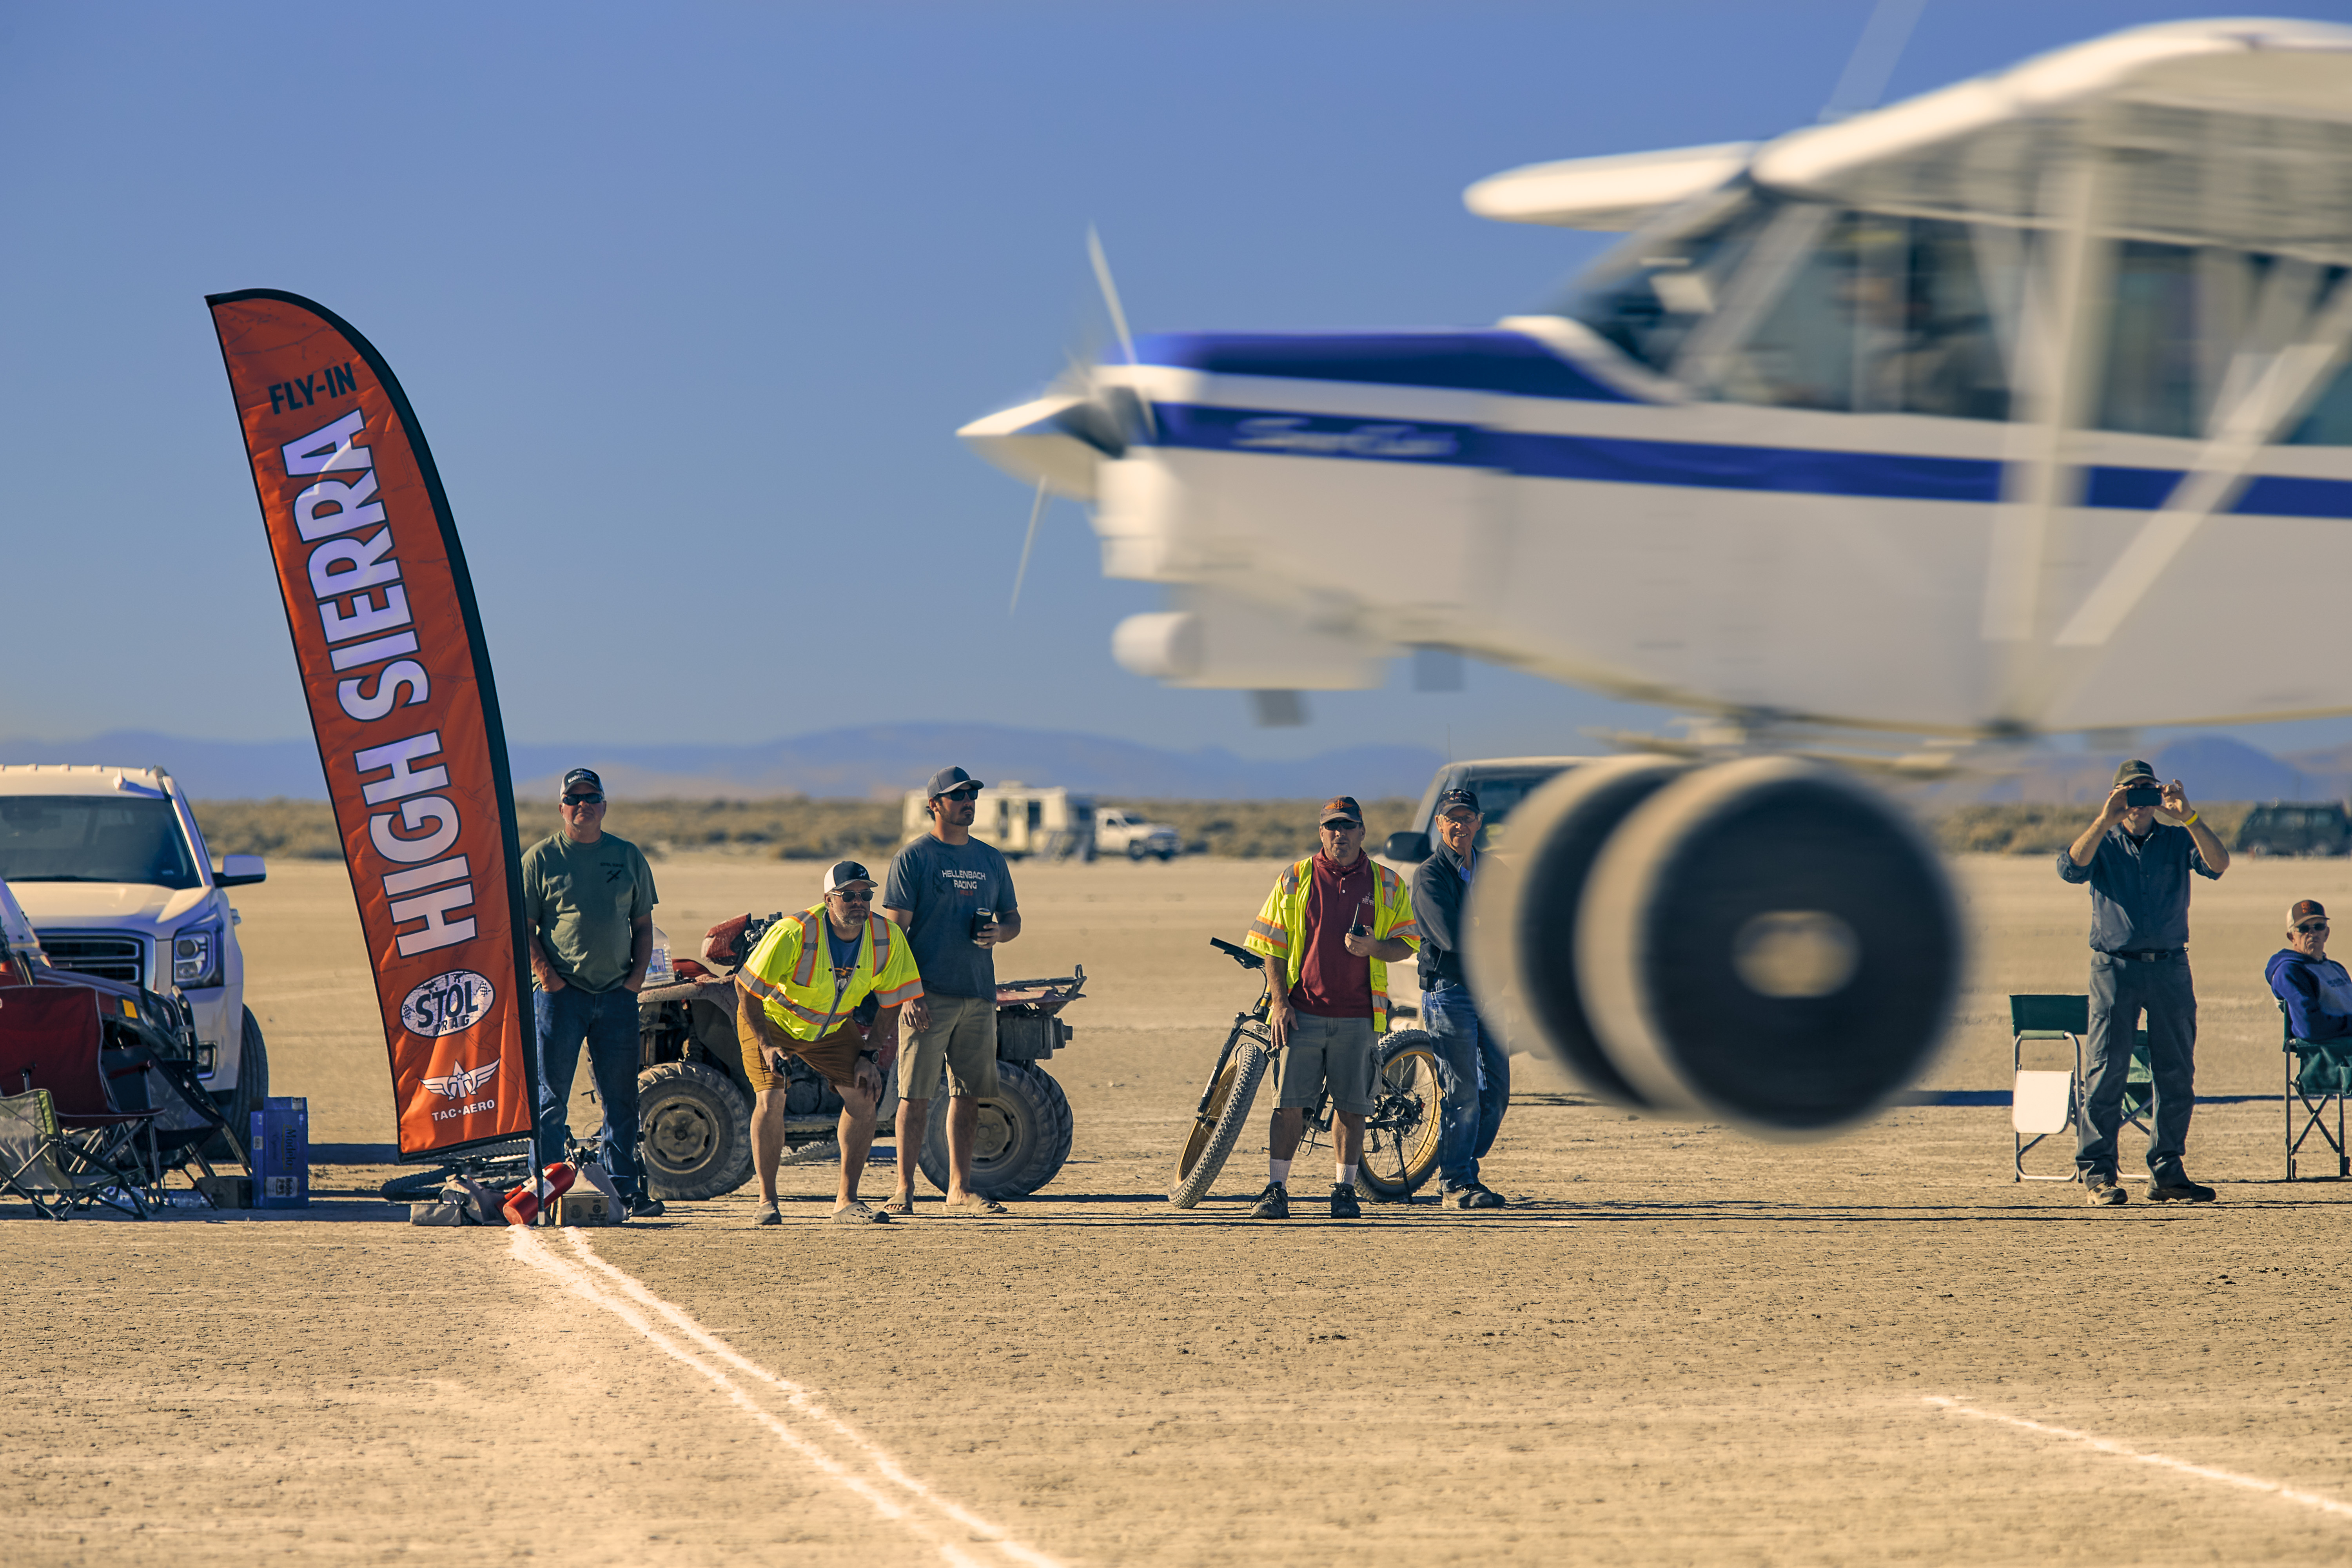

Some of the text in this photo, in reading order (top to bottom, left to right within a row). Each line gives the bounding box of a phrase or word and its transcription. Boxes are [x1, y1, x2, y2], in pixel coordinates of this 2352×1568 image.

[268, 362, 357, 414] FLY-IN
[281, 407, 478, 959] HIGH SIERRA
[942, 870, 986, 881] HELLENBACH
[953, 879, 977, 890] RACING
[416, 980, 478, 1028] STOL
[433, 1014, 470, 1035] DRAG
[285, 1129, 296, 1165] Modelo
